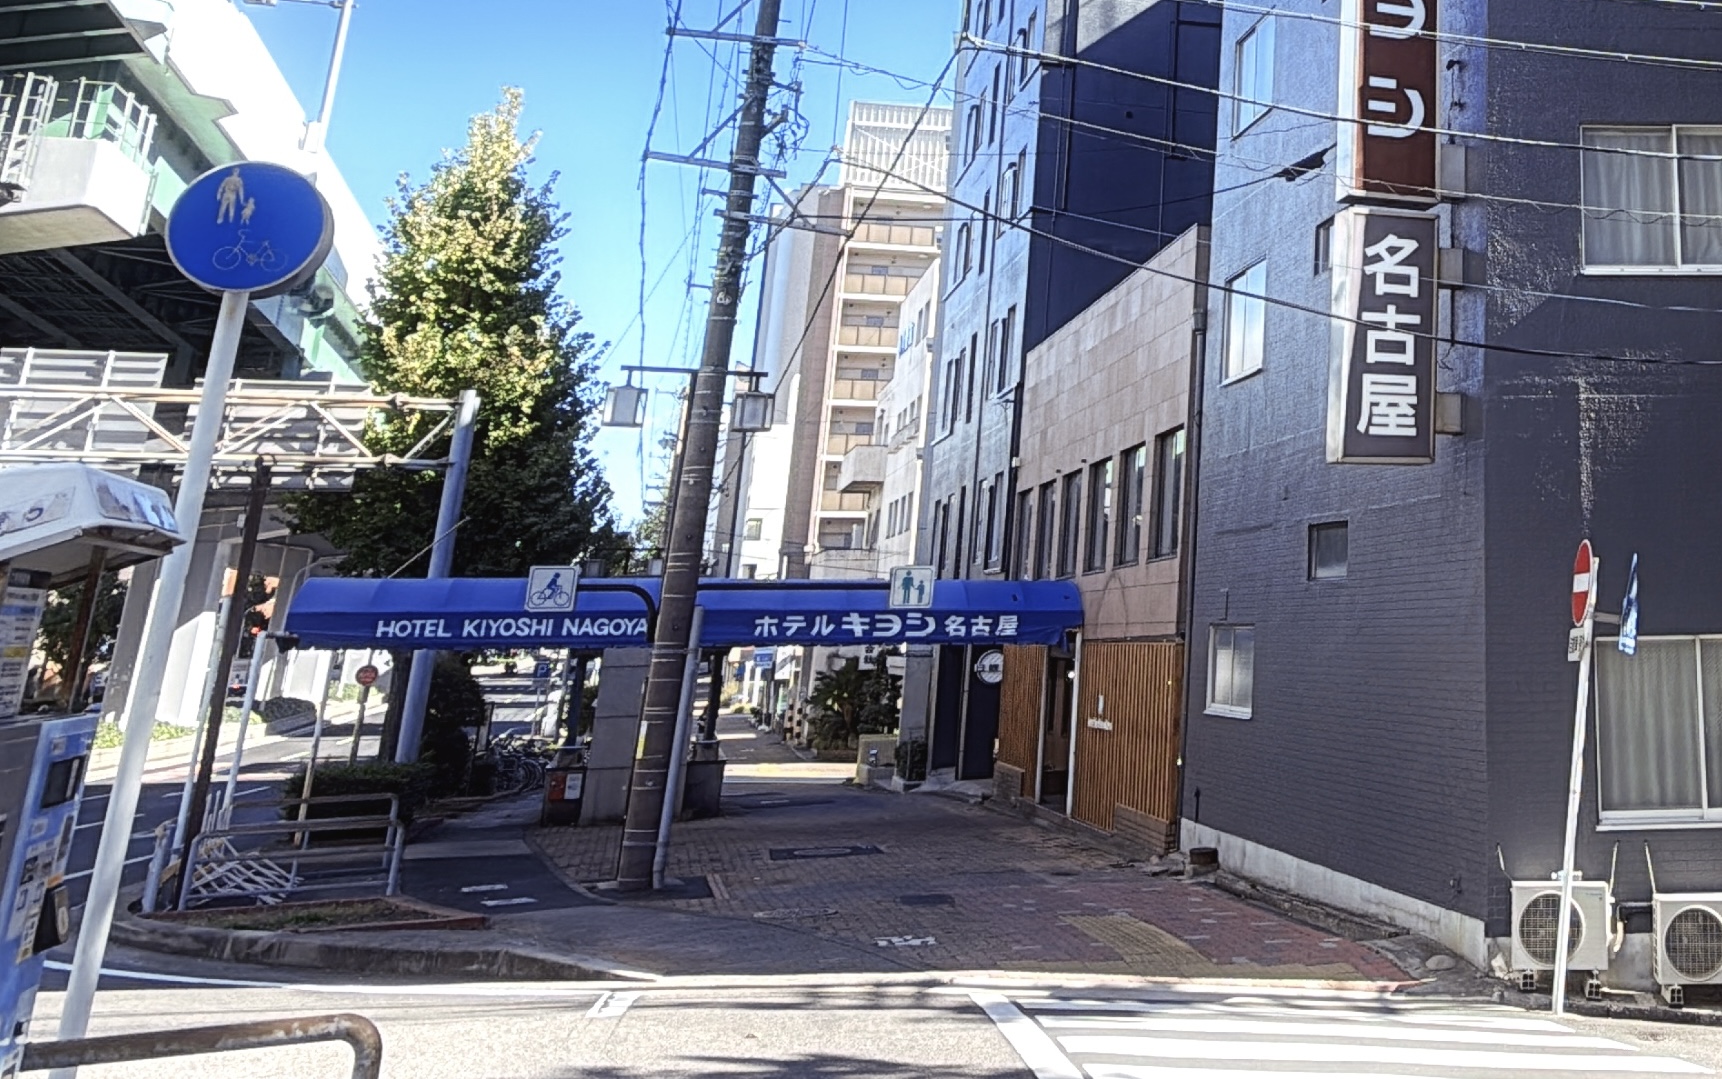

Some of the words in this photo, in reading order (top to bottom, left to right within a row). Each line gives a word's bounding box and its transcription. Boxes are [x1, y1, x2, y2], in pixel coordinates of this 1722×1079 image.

[1357, 233, 1422, 437] 名古屋
[375, 620, 452, 638] HOTEL
[462, 618, 554, 637] KIYOSHI
[561, 618, 648, 636] NAGOYA
